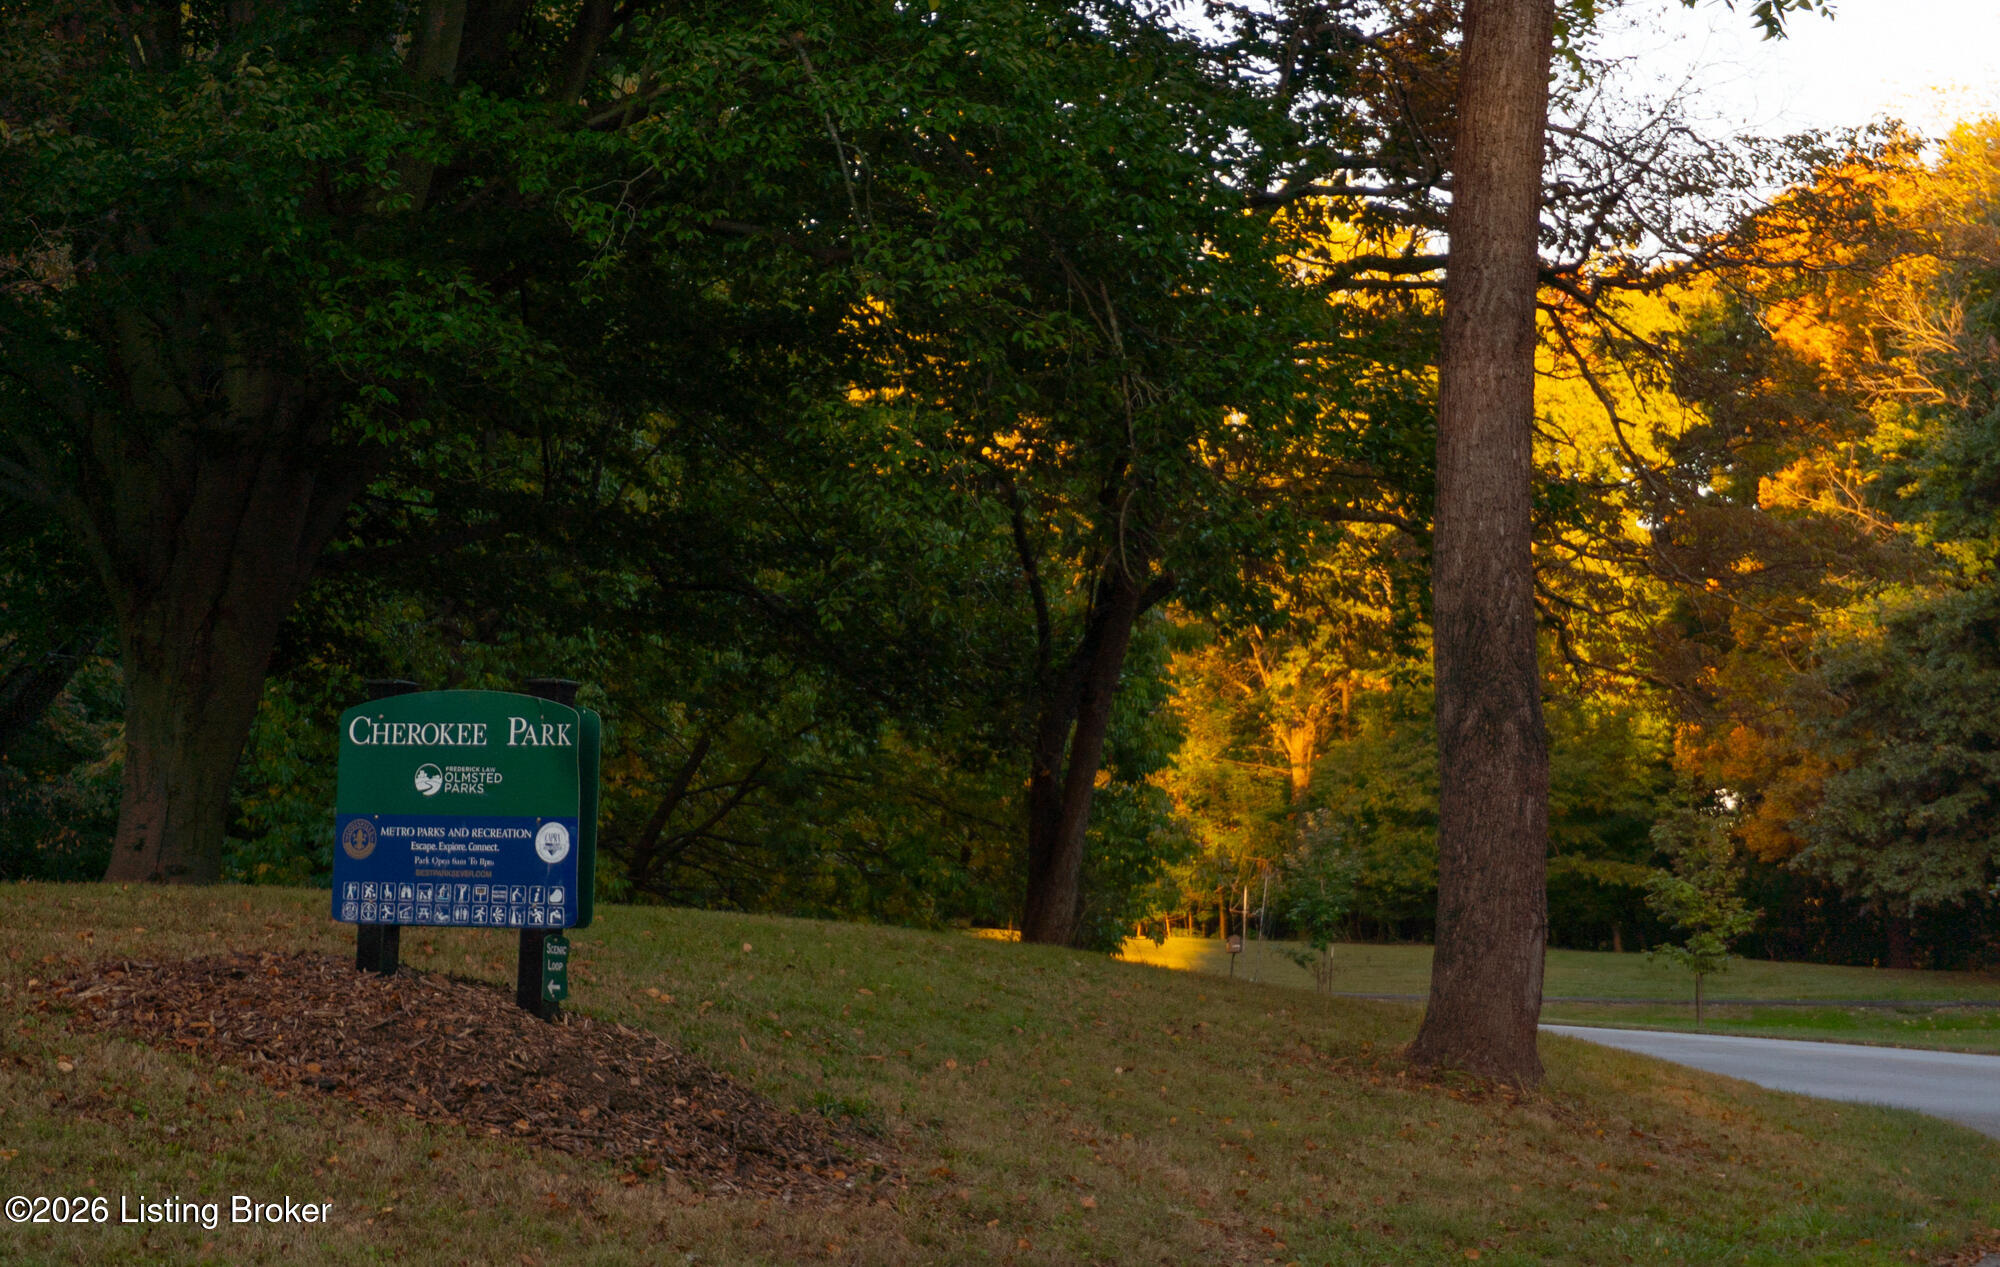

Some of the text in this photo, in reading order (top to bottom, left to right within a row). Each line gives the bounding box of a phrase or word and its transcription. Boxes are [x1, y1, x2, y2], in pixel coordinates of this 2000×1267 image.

[348, 715, 572, 746] CHEROKEE PARK
[444, 772, 503, 784] OLMSTED
[444, 783, 484, 794] PARKS
[380, 826, 415, 837] METRO
[416, 826, 445, 837] PARKS
[448, 827, 469, 838] AND
[471, 828, 532, 839] RECREATION
[410, 841, 500, 853] Escape. Explore. Connect.
[414, 856, 429, 865] Park
[431, 856, 450, 866] Open
[547, 959, 564, 971] LOOP
